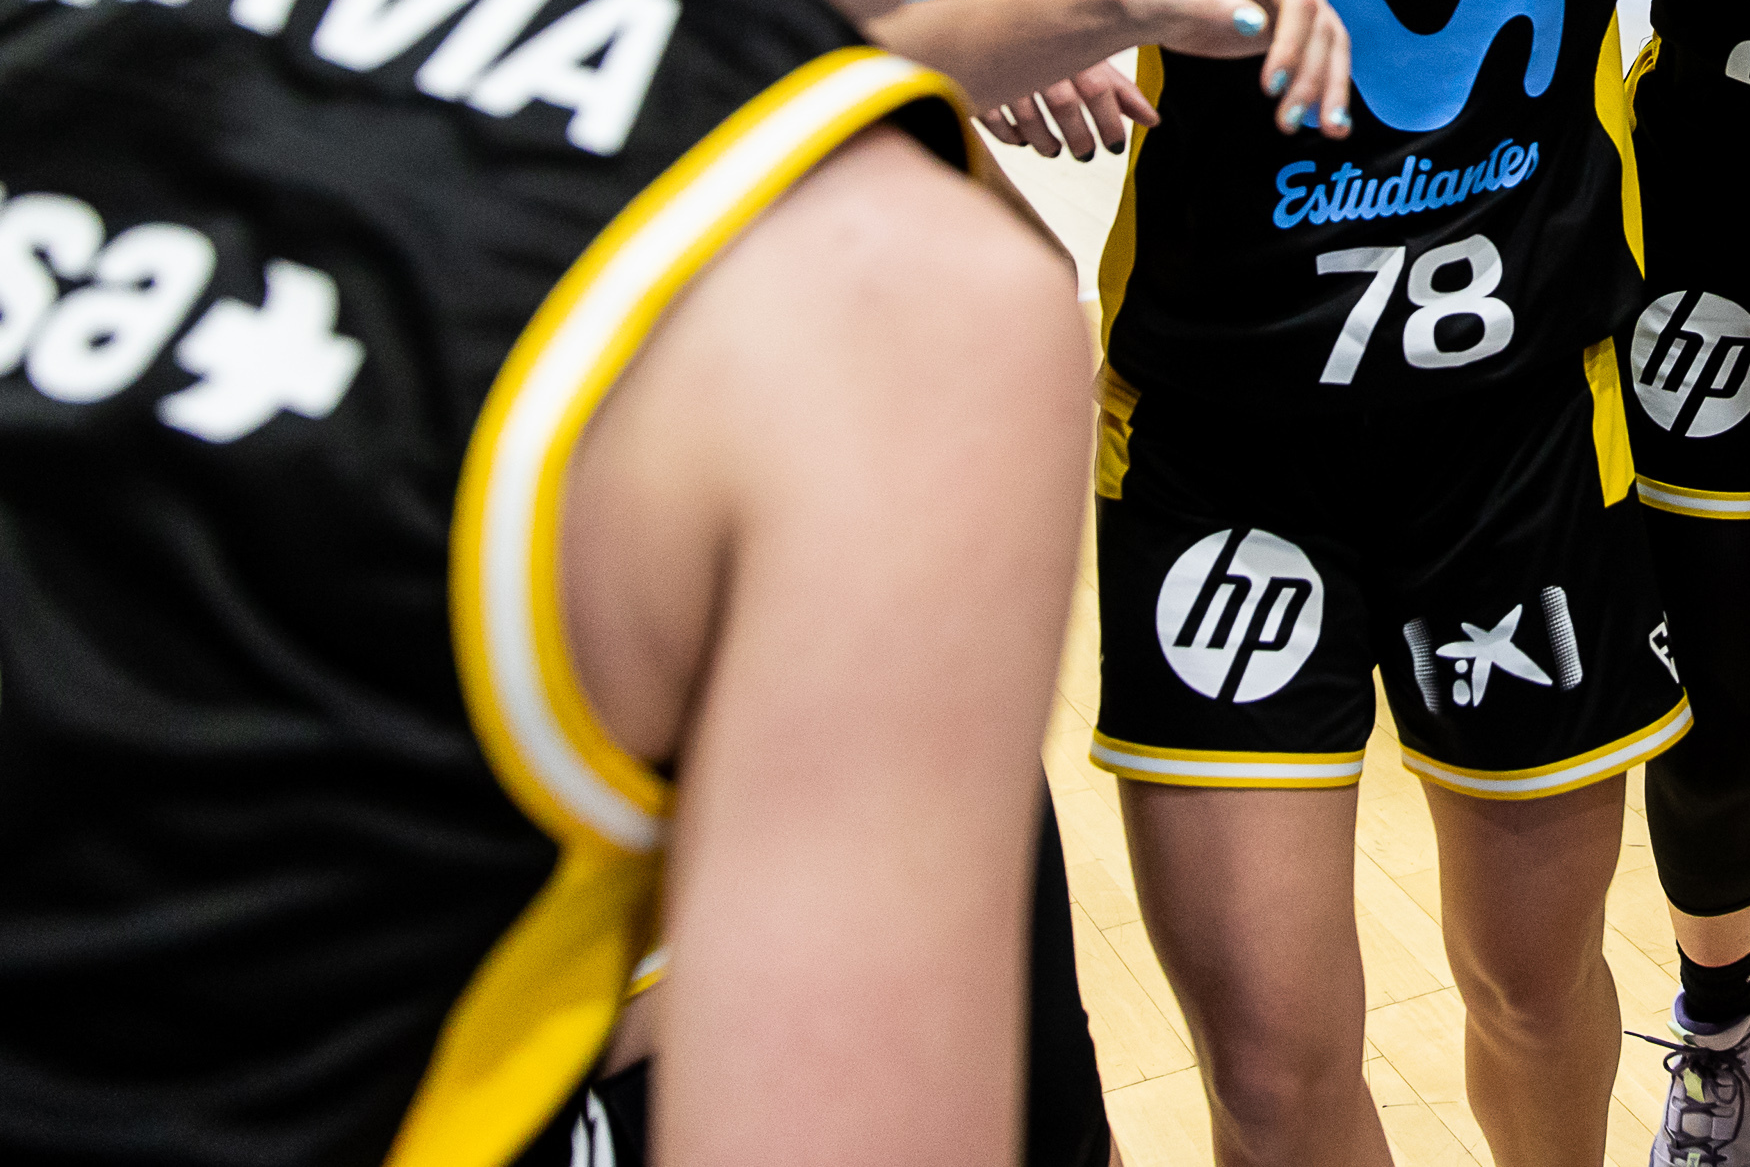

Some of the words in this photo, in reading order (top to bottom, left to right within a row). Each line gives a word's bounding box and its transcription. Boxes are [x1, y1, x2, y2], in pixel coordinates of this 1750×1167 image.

[1272, 138, 1539, 229] Estudiantes
[1315, 233, 1515, 386] 78
[1162, 528, 1322, 702] hp
